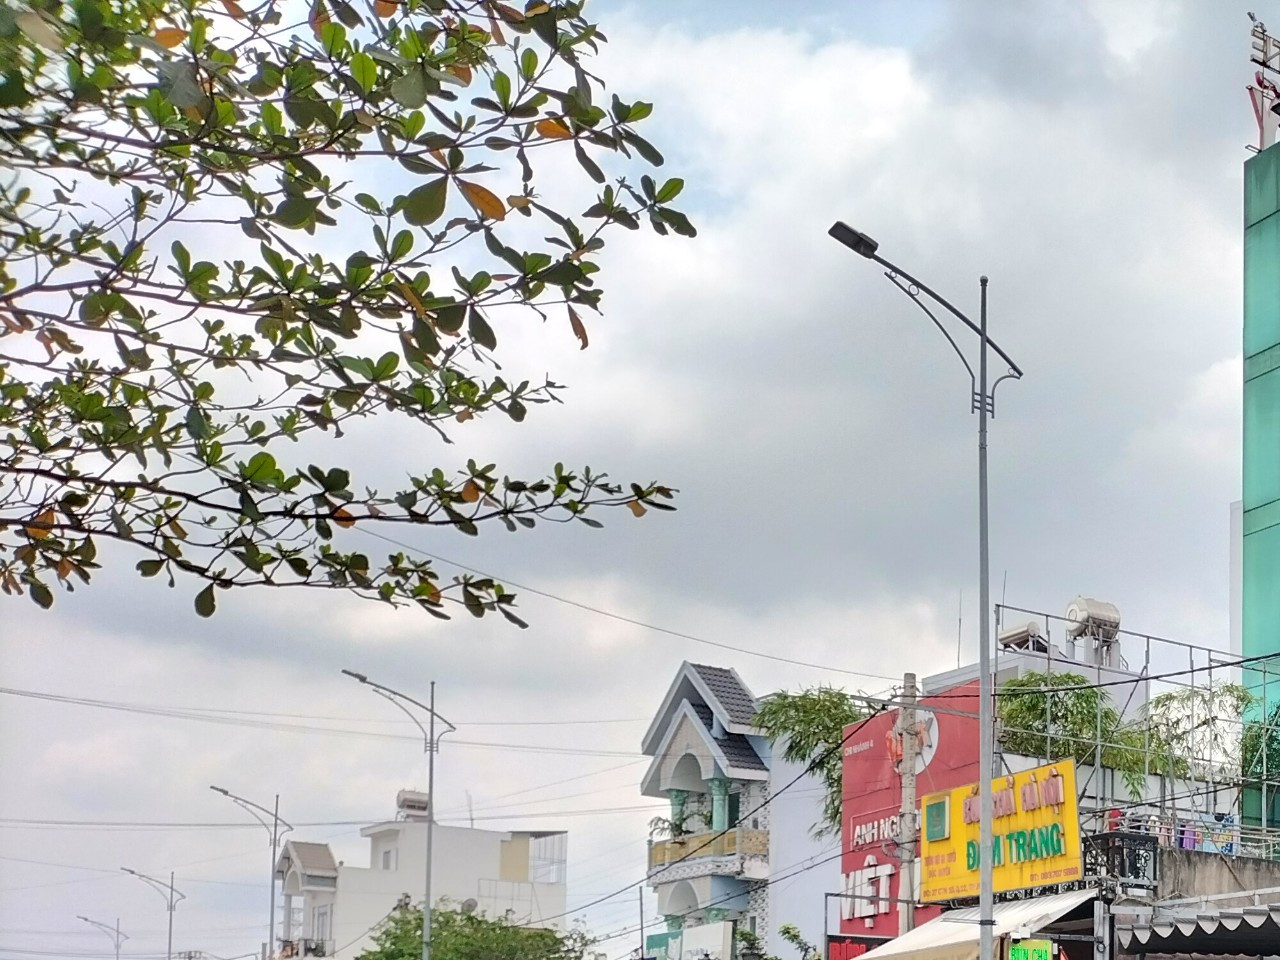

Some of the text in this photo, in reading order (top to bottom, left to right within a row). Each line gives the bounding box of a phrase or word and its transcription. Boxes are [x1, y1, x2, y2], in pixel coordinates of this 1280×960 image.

[853, 820, 878, 846] ANH
[1006, 823, 1066, 864] TRANG
[841, 854, 896, 928] VIỆT
